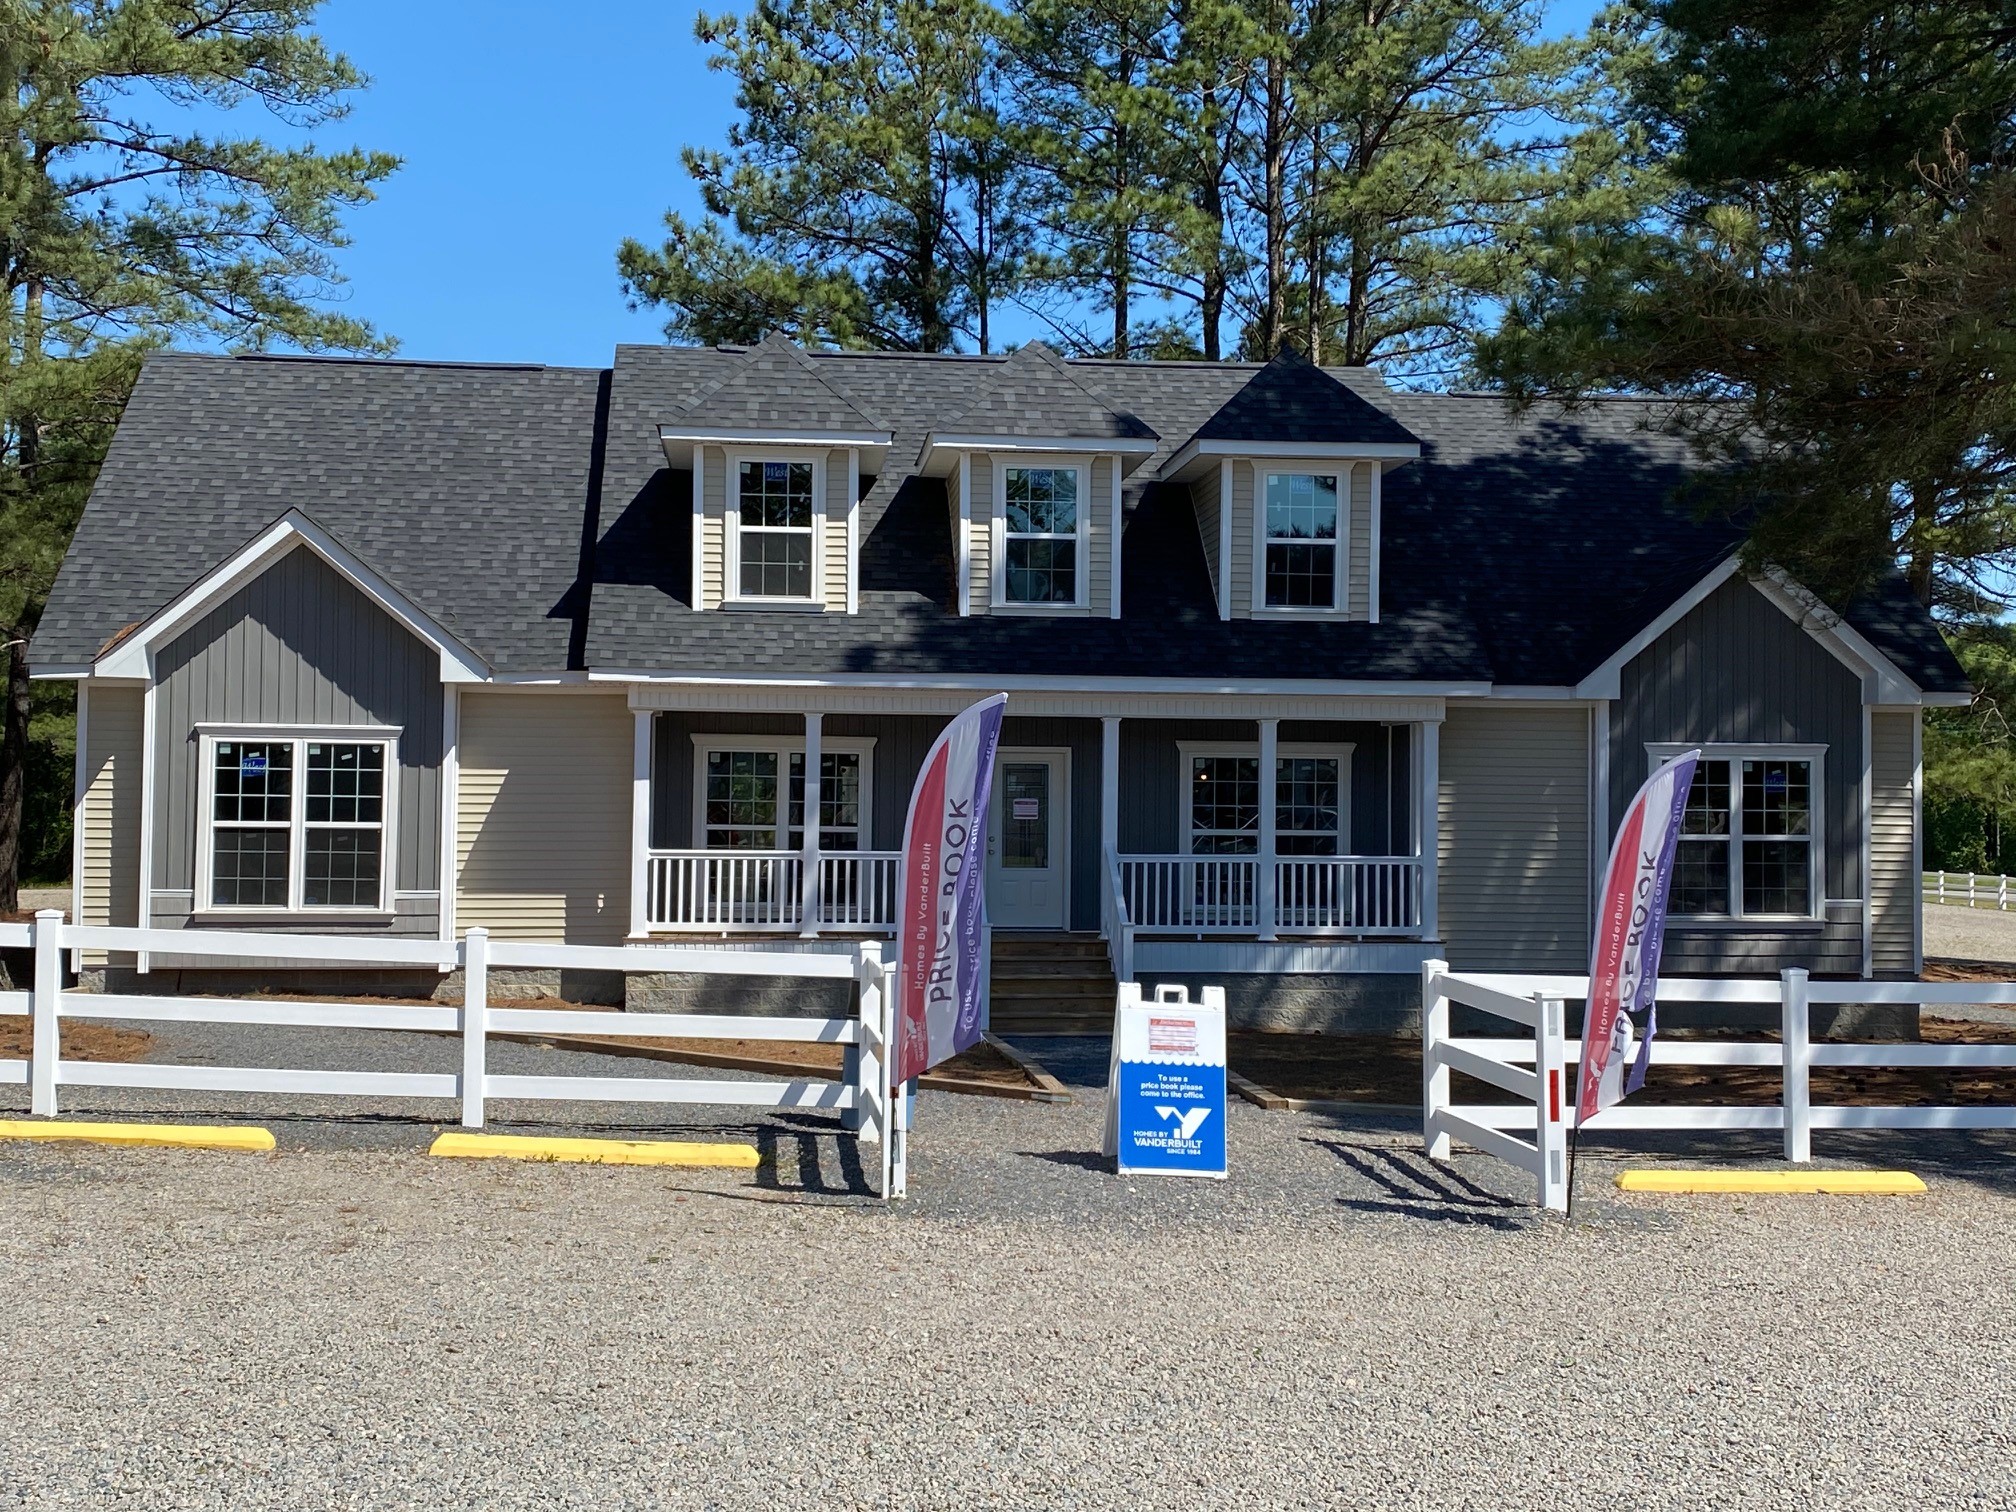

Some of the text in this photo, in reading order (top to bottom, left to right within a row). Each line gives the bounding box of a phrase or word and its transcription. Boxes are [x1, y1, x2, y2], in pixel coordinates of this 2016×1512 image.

[943, 798, 968, 897] BOOK
[914, 842, 932, 990] Homes By VanderBuilt
[1627, 851, 1656, 947] BOOK
[1598, 892, 1626, 1035] Homes By VanderBuilt
[1140, 1082, 1203, 1091] price book please
[1183, 1091, 1205, 1099] office.
[1133, 1137, 1203, 1149] VANDERBUILT
